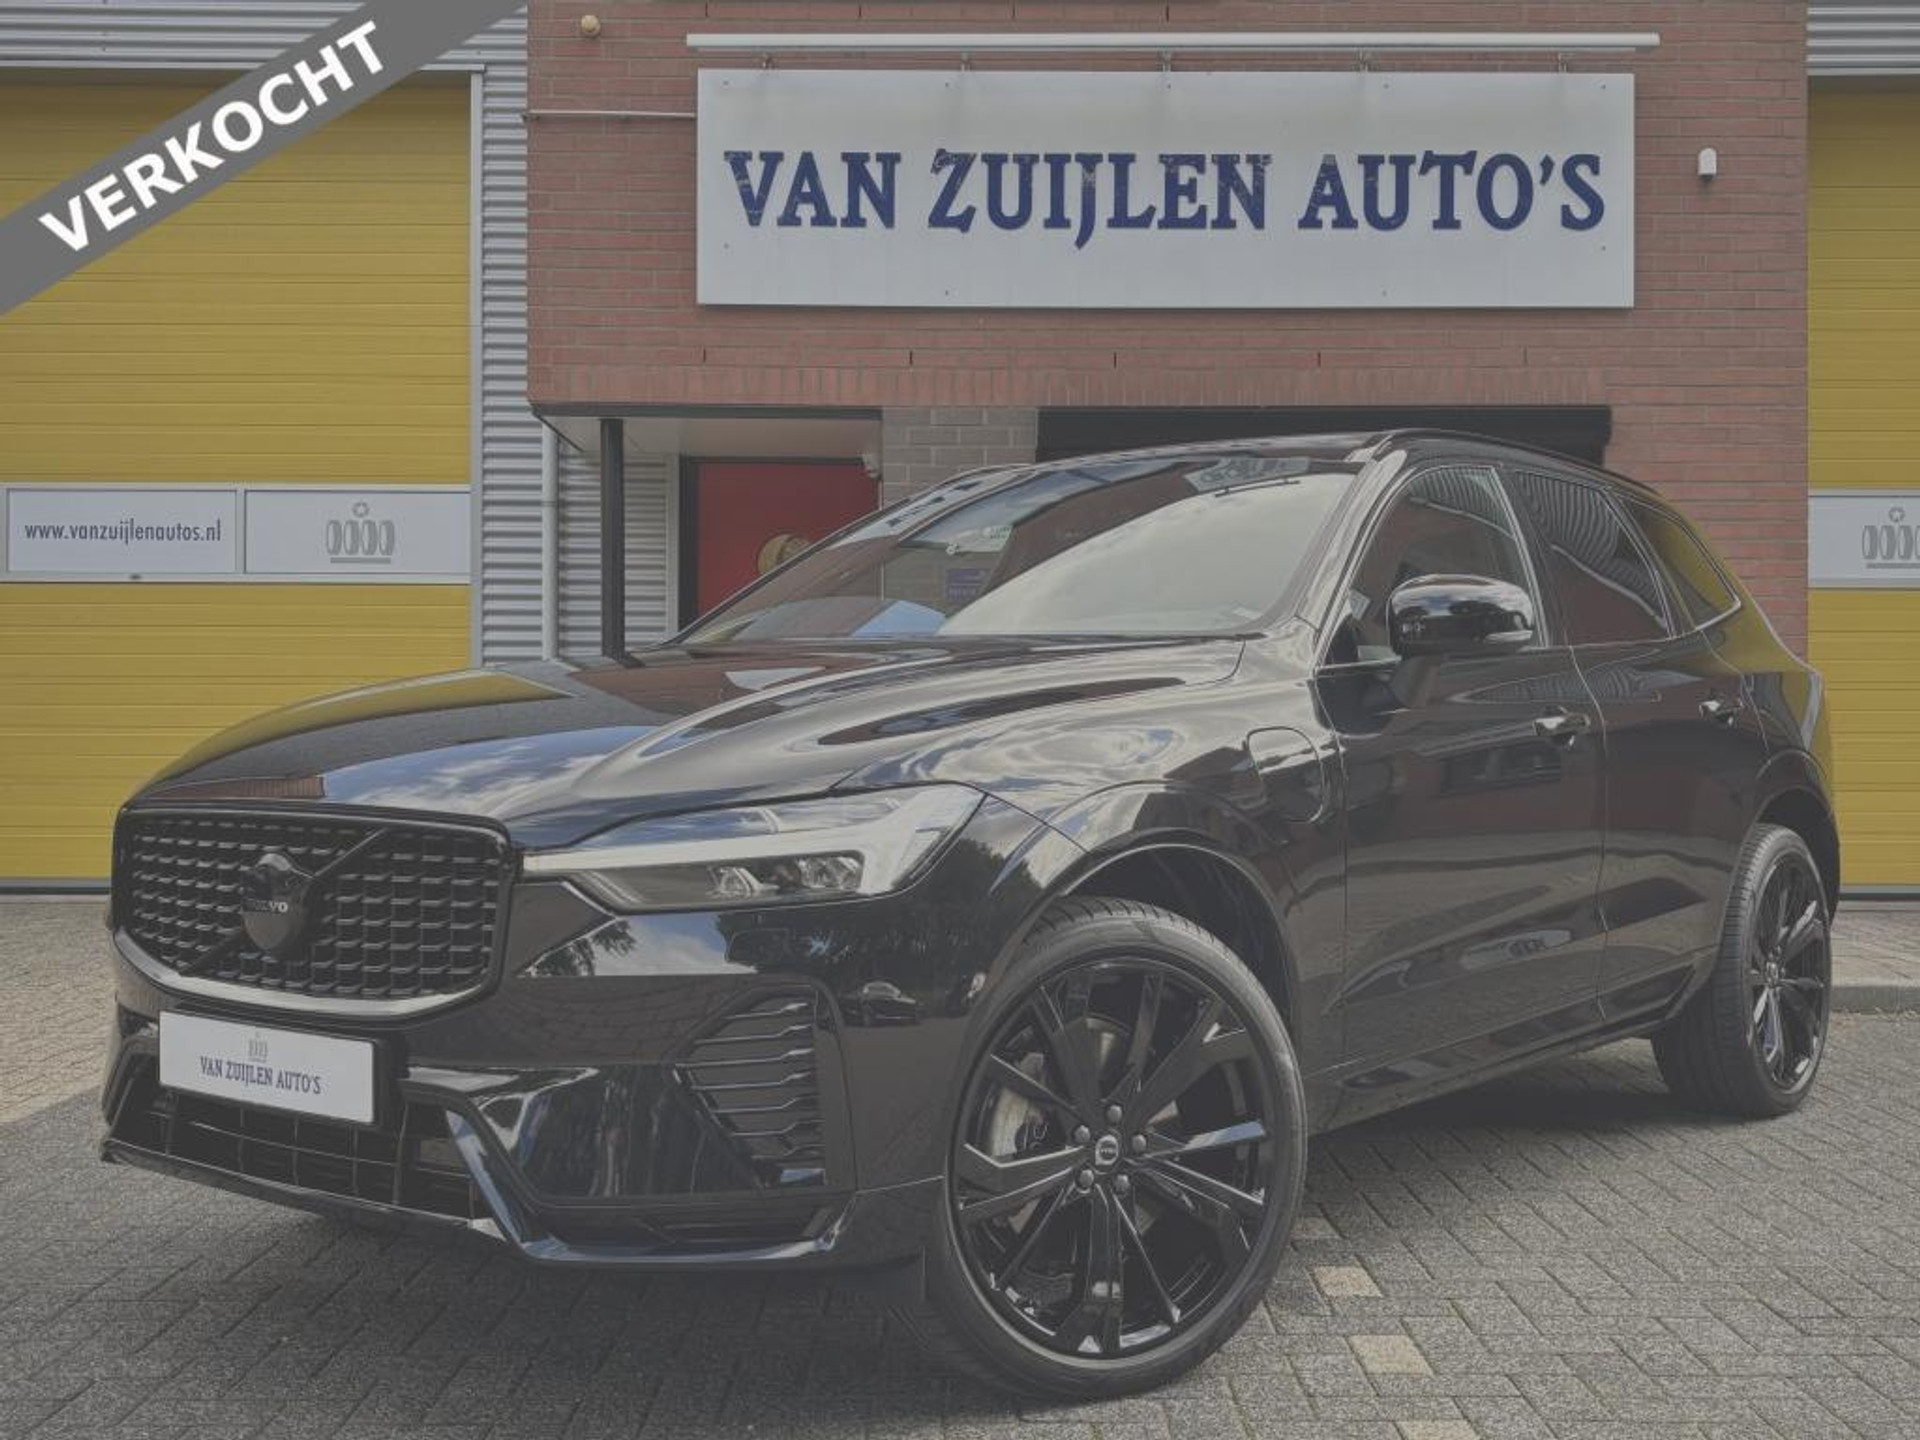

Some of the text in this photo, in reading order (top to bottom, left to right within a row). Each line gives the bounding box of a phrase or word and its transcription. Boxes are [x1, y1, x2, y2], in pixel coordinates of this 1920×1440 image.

[724, 148, 1605, 250] VAN ZUIJLEN AUTO'S
[24, 518, 221, 545] www.vanzuijlenautos.nl
[200, 1056, 321, 1094] VAN ZUIJLEN AUTO'S
